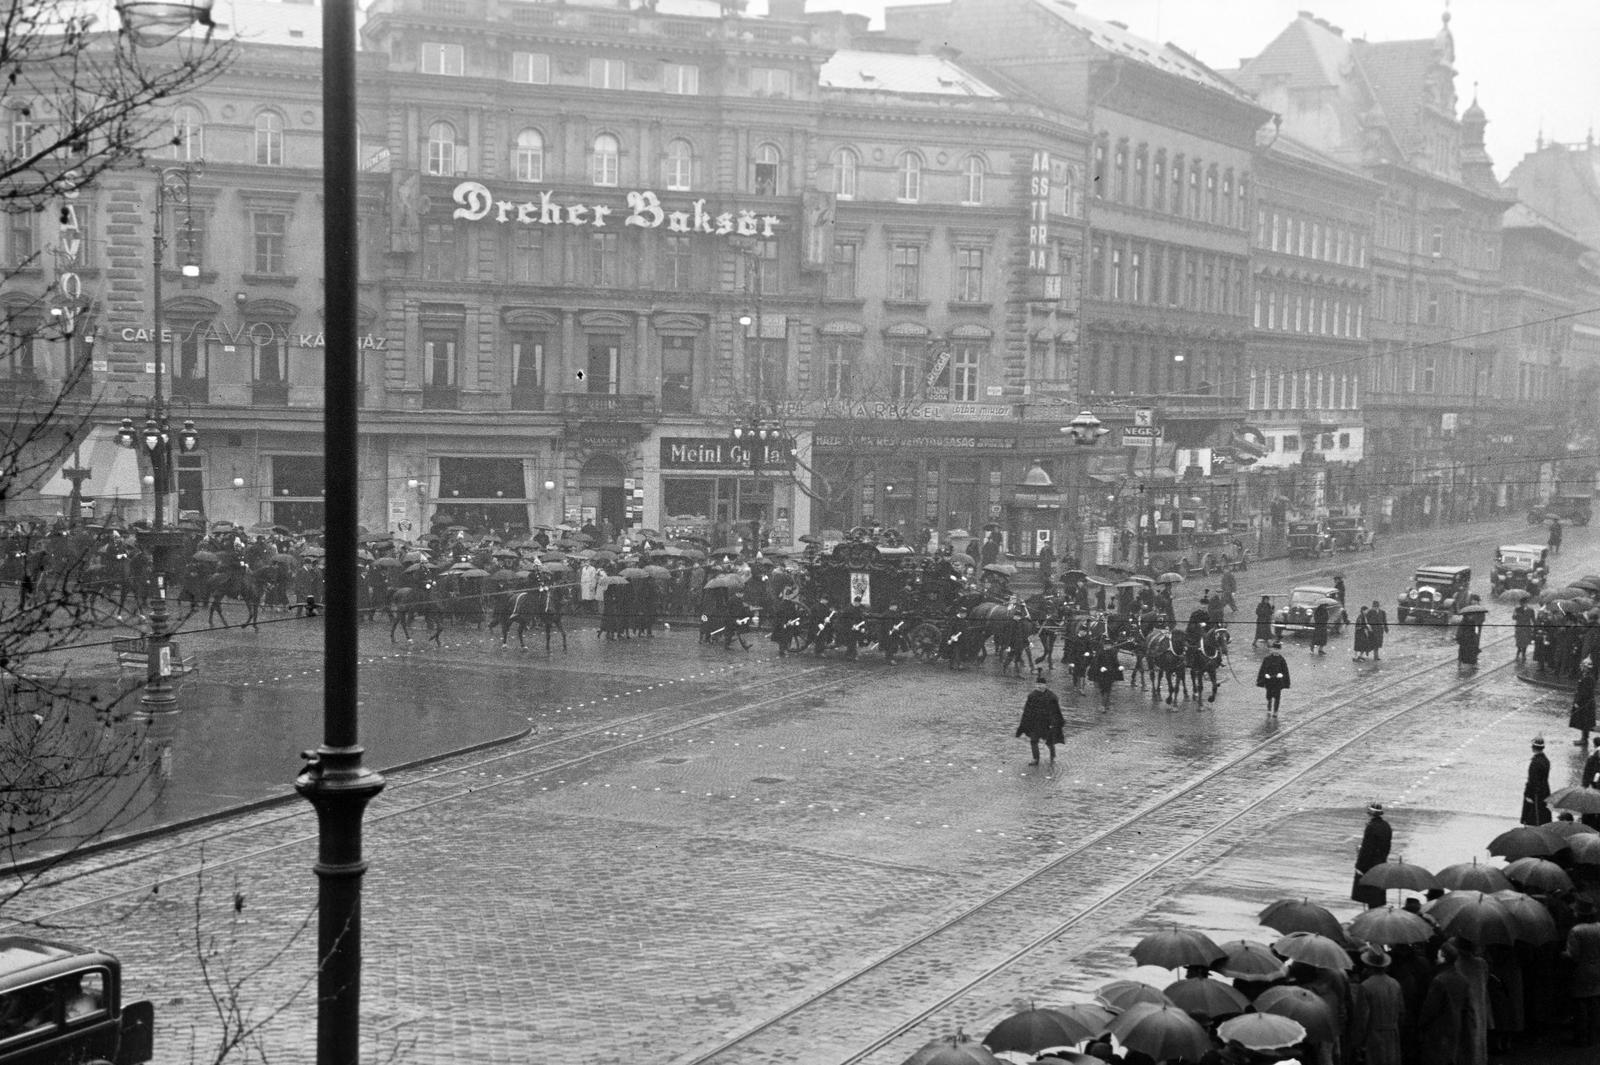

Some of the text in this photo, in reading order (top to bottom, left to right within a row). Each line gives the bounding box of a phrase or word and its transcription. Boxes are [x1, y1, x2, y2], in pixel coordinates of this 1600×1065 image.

[452, 181, 780, 237] Dreher Baksör
[1029, 152, 1040, 270] ASTRA
[1037, 152, 1049, 270] ASTRA
[183, 321, 292, 347] SAVOY
[671, 443, 780, 467] Meinl Gyla
